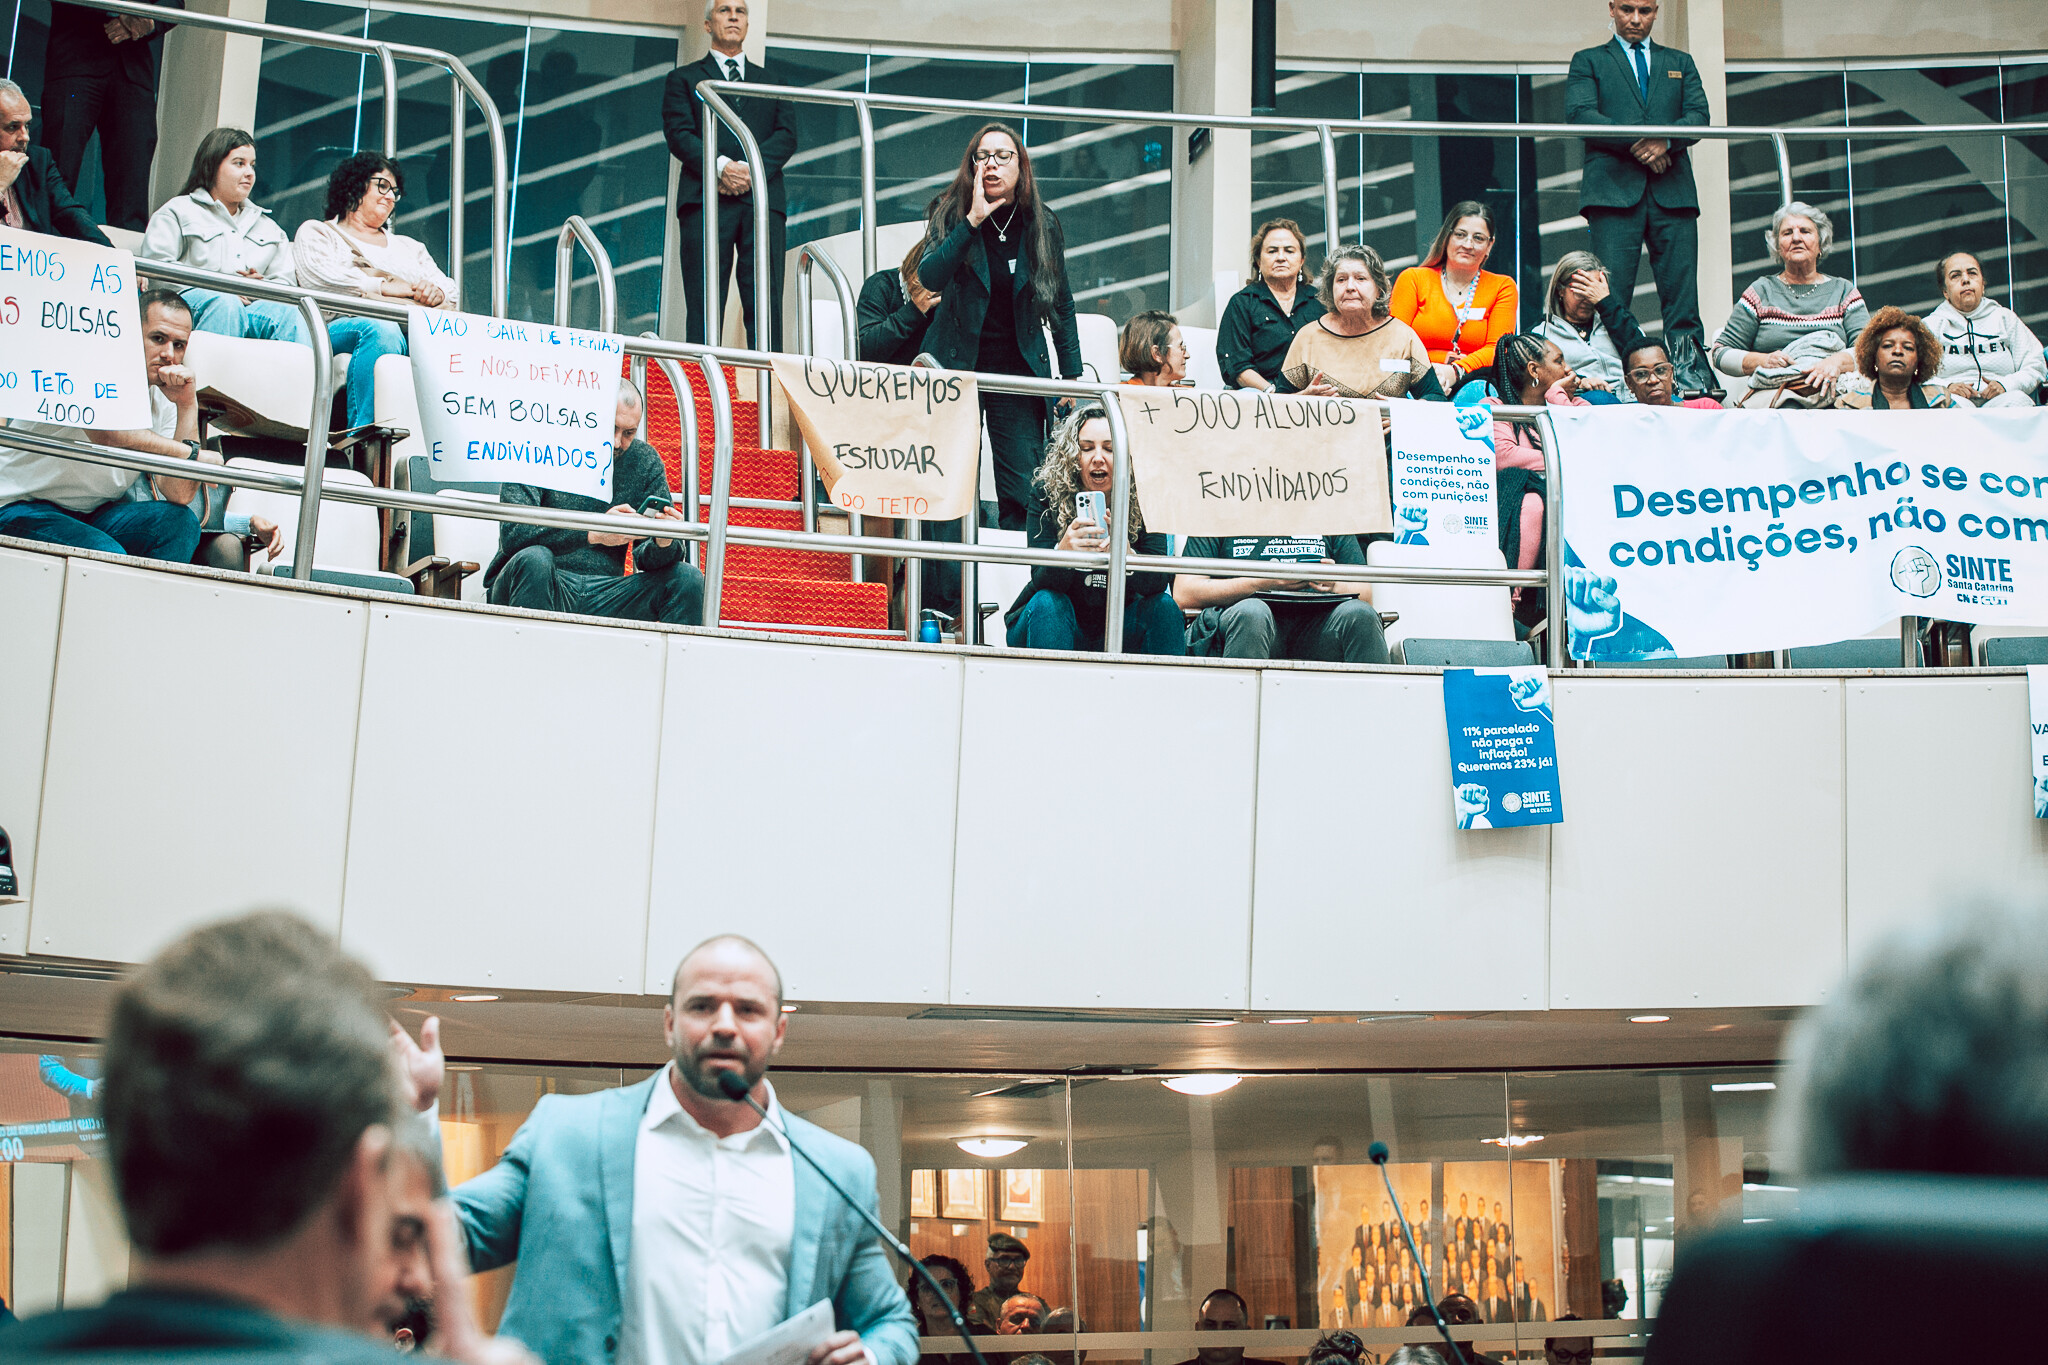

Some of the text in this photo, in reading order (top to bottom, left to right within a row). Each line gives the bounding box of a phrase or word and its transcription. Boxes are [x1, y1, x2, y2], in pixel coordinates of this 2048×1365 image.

[90, 263, 123, 294] AS
[0, 296, 121, 338] S BOLSAS
[487, 322, 529, 343] SAIR
[540, 329, 561, 345] DE
[1943, 341, 2006, 355] AKLEY
[449, 353, 601, 390] E NOS DEIXAR
[31, 369, 74, 395] TETO
[94, 382, 119, 399] DE
[804, 356, 963, 415] QUEREMOS
[37, 398, 95, 425] 4.000
[442, 391, 598, 429] SEM BOLSAS
[1172, 389, 1241, 434] 500
[1254, 394, 1356, 430] ALUNOS
[432, 441, 443, 463] E
[833, 443, 944, 477] ESTUDAR
[1397, 450, 1491, 465] Desempenho se
[1406, 465, 1483, 477] constrói com
[1198, 466, 1349, 502] ENDIVIDADOS
[1400, 477, 1490, 490] condições, não
[1613, 461, 1911, 519] Desempenho
[1921, 463, 1968, 491] se
[841, 492, 929, 515] DO TETO
[1402, 490, 1488, 504] com punições!
[1464, 515, 1488, 526] SINTE
[1608, 496, 2048, 571] condições, não com
[1268, 546, 1311, 554] REAJUSTE
[1945, 553, 2013, 583] SINTE
[1947, 578, 2014, 593] Santa Catarina
[1462, 723, 1540, 738] 11% parcelado
[1471, 736, 1534, 749] não paga a
[1478, 746, 1528, 760] inflação!
[1457, 756, 1553, 774] Queremos 23% já!
[1521, 790, 1551, 804] SINTE
